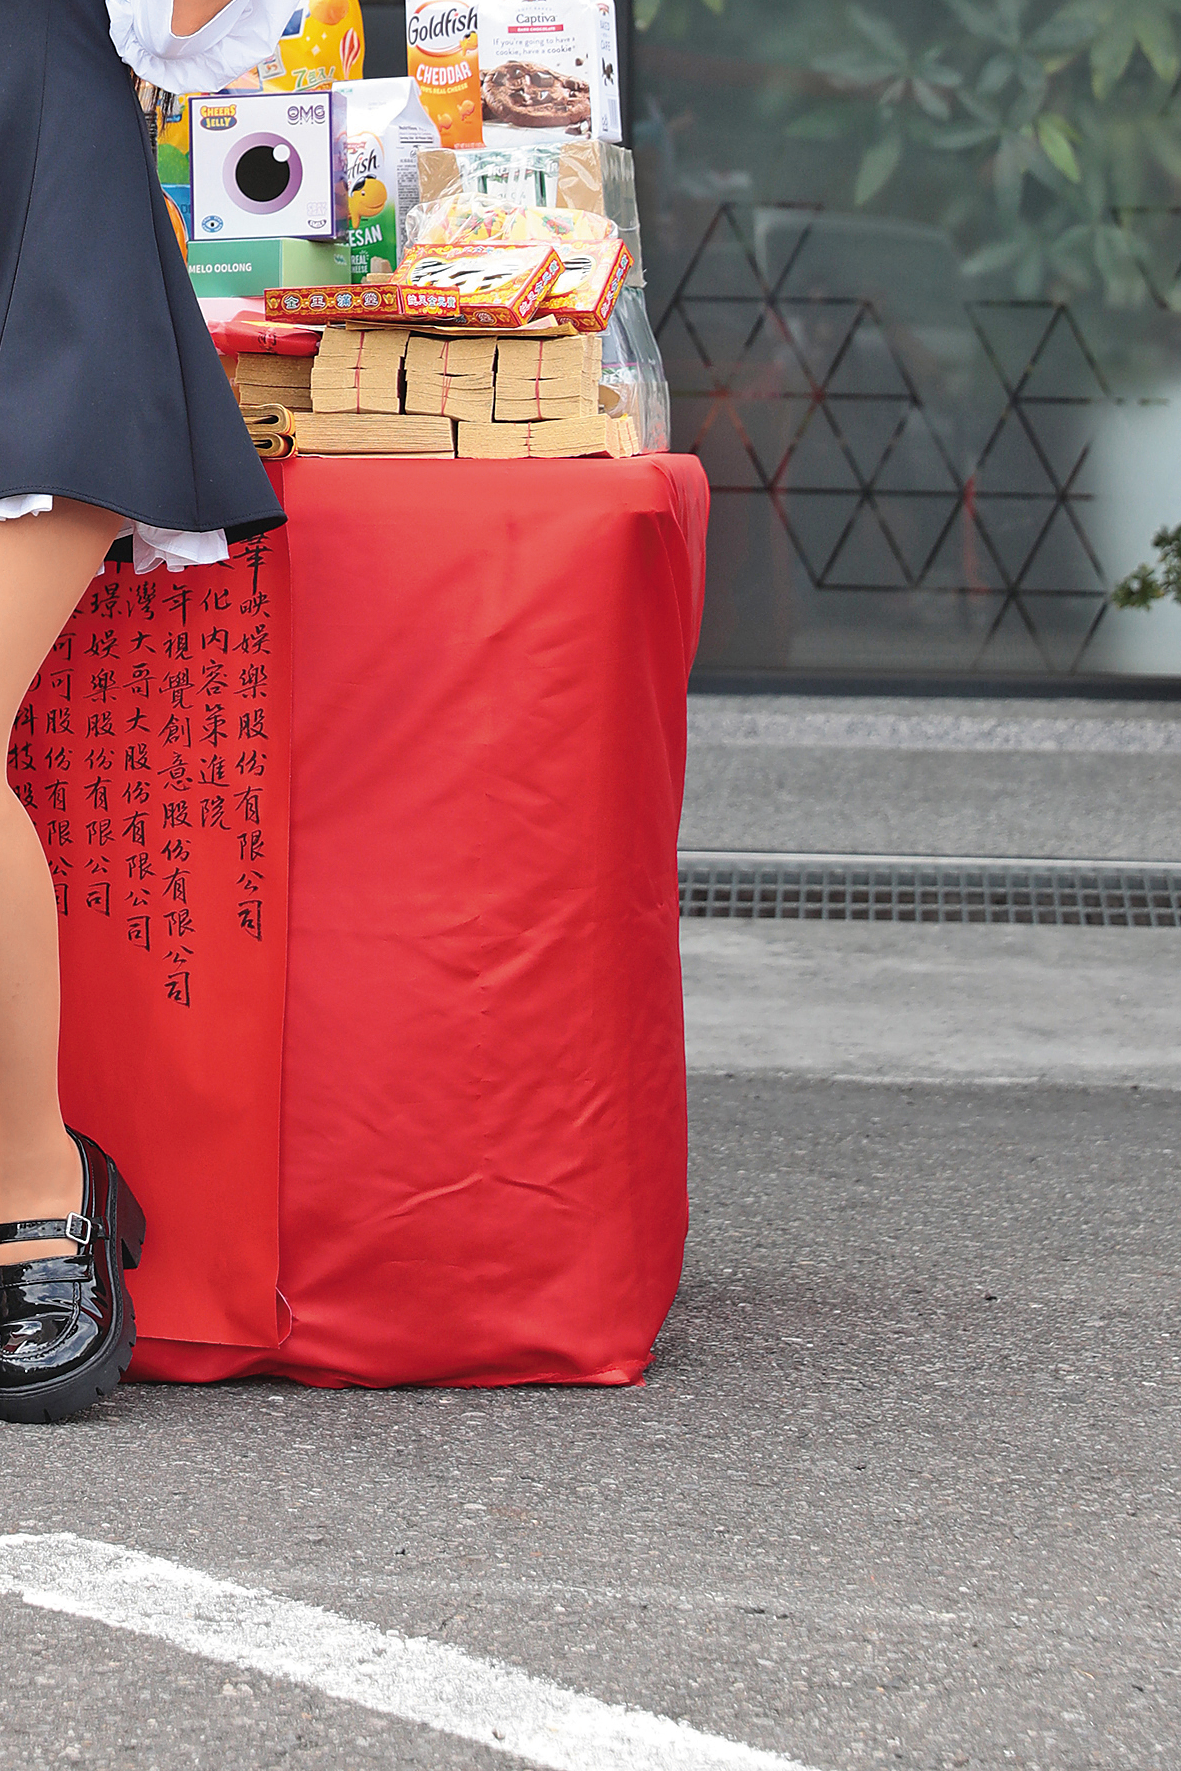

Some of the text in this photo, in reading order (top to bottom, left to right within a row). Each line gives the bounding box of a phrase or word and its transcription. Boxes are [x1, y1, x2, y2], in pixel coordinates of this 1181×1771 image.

[408, 6, 479, 46] Goldfish
[516, 13, 556, 26] Captiva
[525, 38, 545, 47] going
[555, 36, 571, 44] have
[523, 47, 540, 55] have
[416, 61, 472, 87] CHEDDAR
[433, 84, 447, 95] REAL
[447, 83, 469, 94] CHEESE
[200, 104, 237, 117] CHEERS
[287, 105, 326, 121] OMG
[206, 117, 232, 128] JELLY
[347, 149, 379, 179] fish
[349, 224, 383, 247] ESAN
[188, 262, 253, 274] MELO OOLONG
[351, 264, 368, 273] HEESE
[82, 573, 123, 918] 璟娛樂股份有限公司
[44, 613, 82, 918] 可可股份有限公司
[121, 581, 158, 953] 灣大哥大股份有限公司
[158, 582, 197, 1009] 年視覺創意股份有限公司
